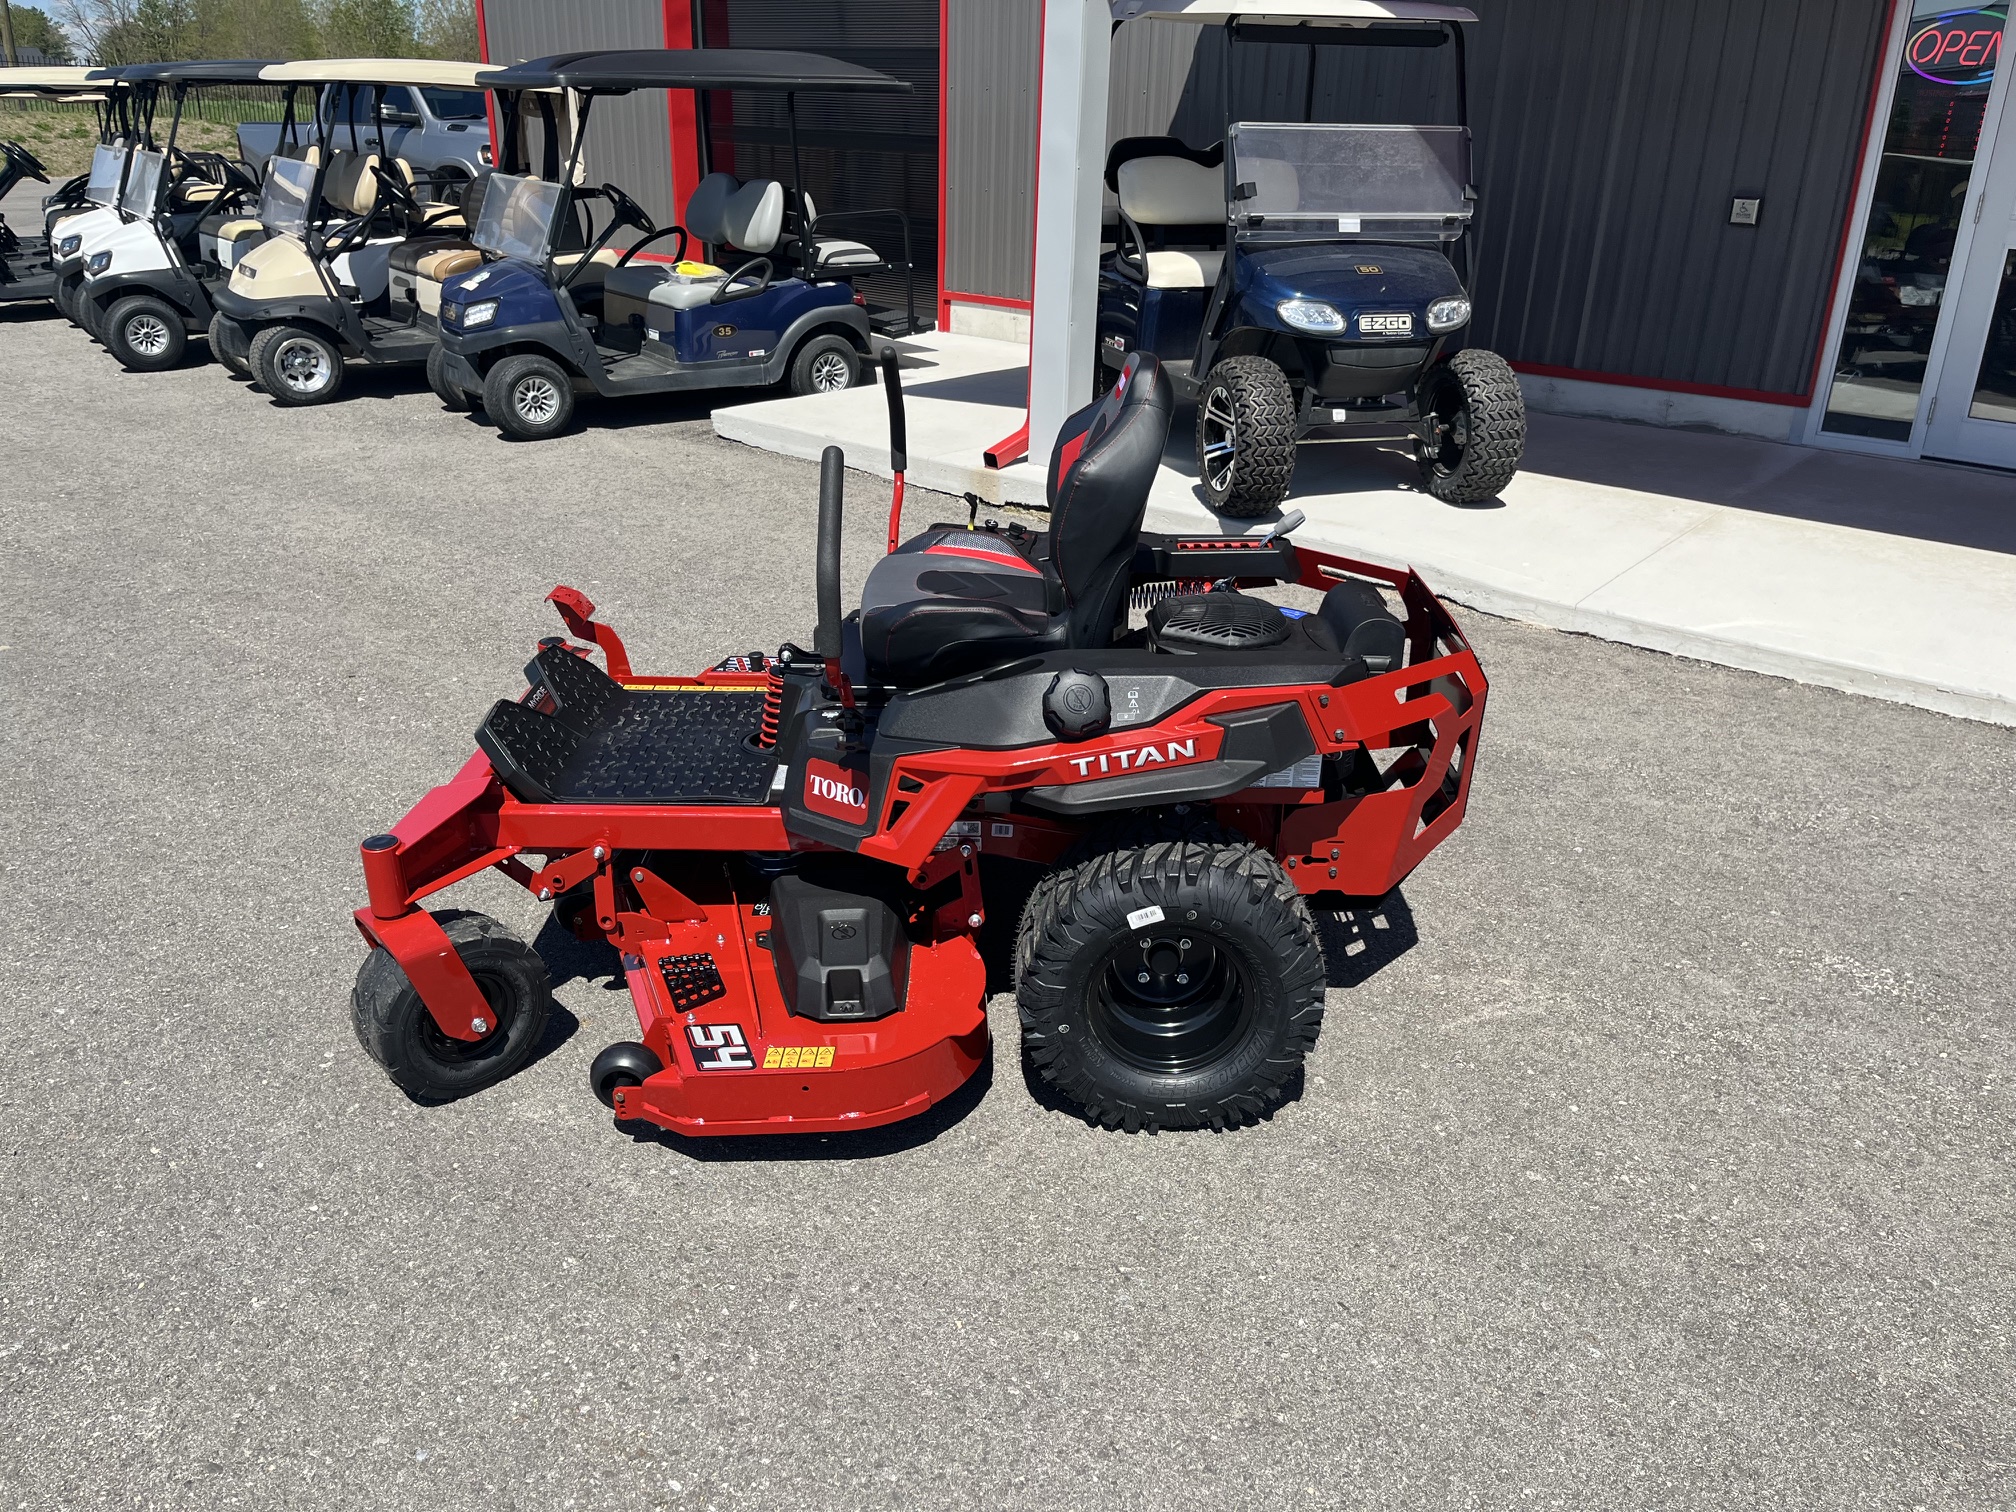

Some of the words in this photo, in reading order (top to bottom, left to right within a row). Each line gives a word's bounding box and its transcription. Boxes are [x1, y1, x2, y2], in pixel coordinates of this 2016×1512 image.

[1912, 30, 2002, 66] OPEN
[718, 327, 732, 336] 35
[1069, 739, 1195, 777] TITAN
[810, 774, 864, 807] TORO
[685, 1025, 754, 1070] 54
